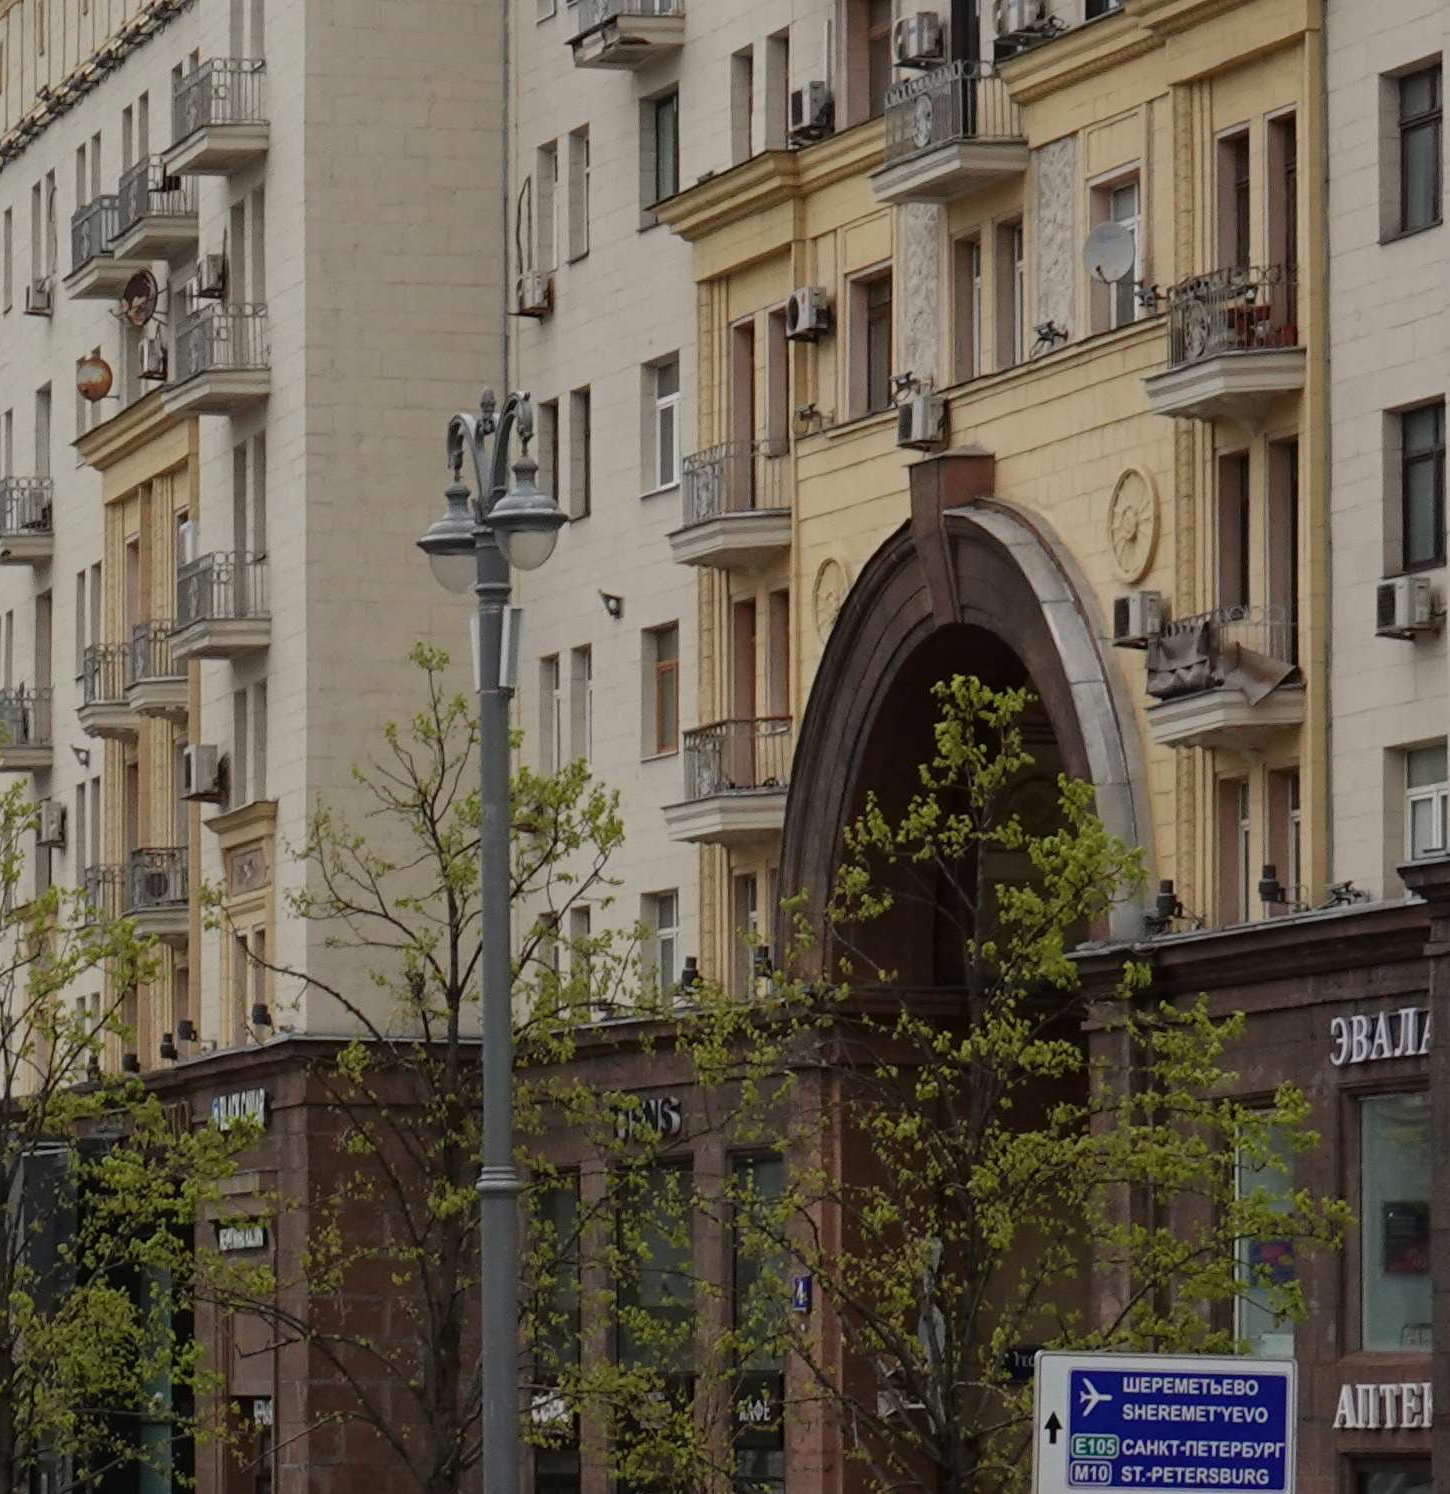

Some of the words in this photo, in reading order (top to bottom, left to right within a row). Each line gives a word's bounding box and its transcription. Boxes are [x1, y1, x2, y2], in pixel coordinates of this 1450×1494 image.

[1122, 1376, 1259, 1396] ШЕРЕМЕТЬЕВО
[1122, 1403, 1269, 1424] SHEREMET'YEVO
[1075, 1437, 1116, 1455] E105
[1121, 1438, 1285, 1459] САНКТ-ПЕТЕРБУРГ
[1074, 1464, 1109, 1482] M10
[1120, 1465, 1270, 1486] ST.-PETERSBURG
